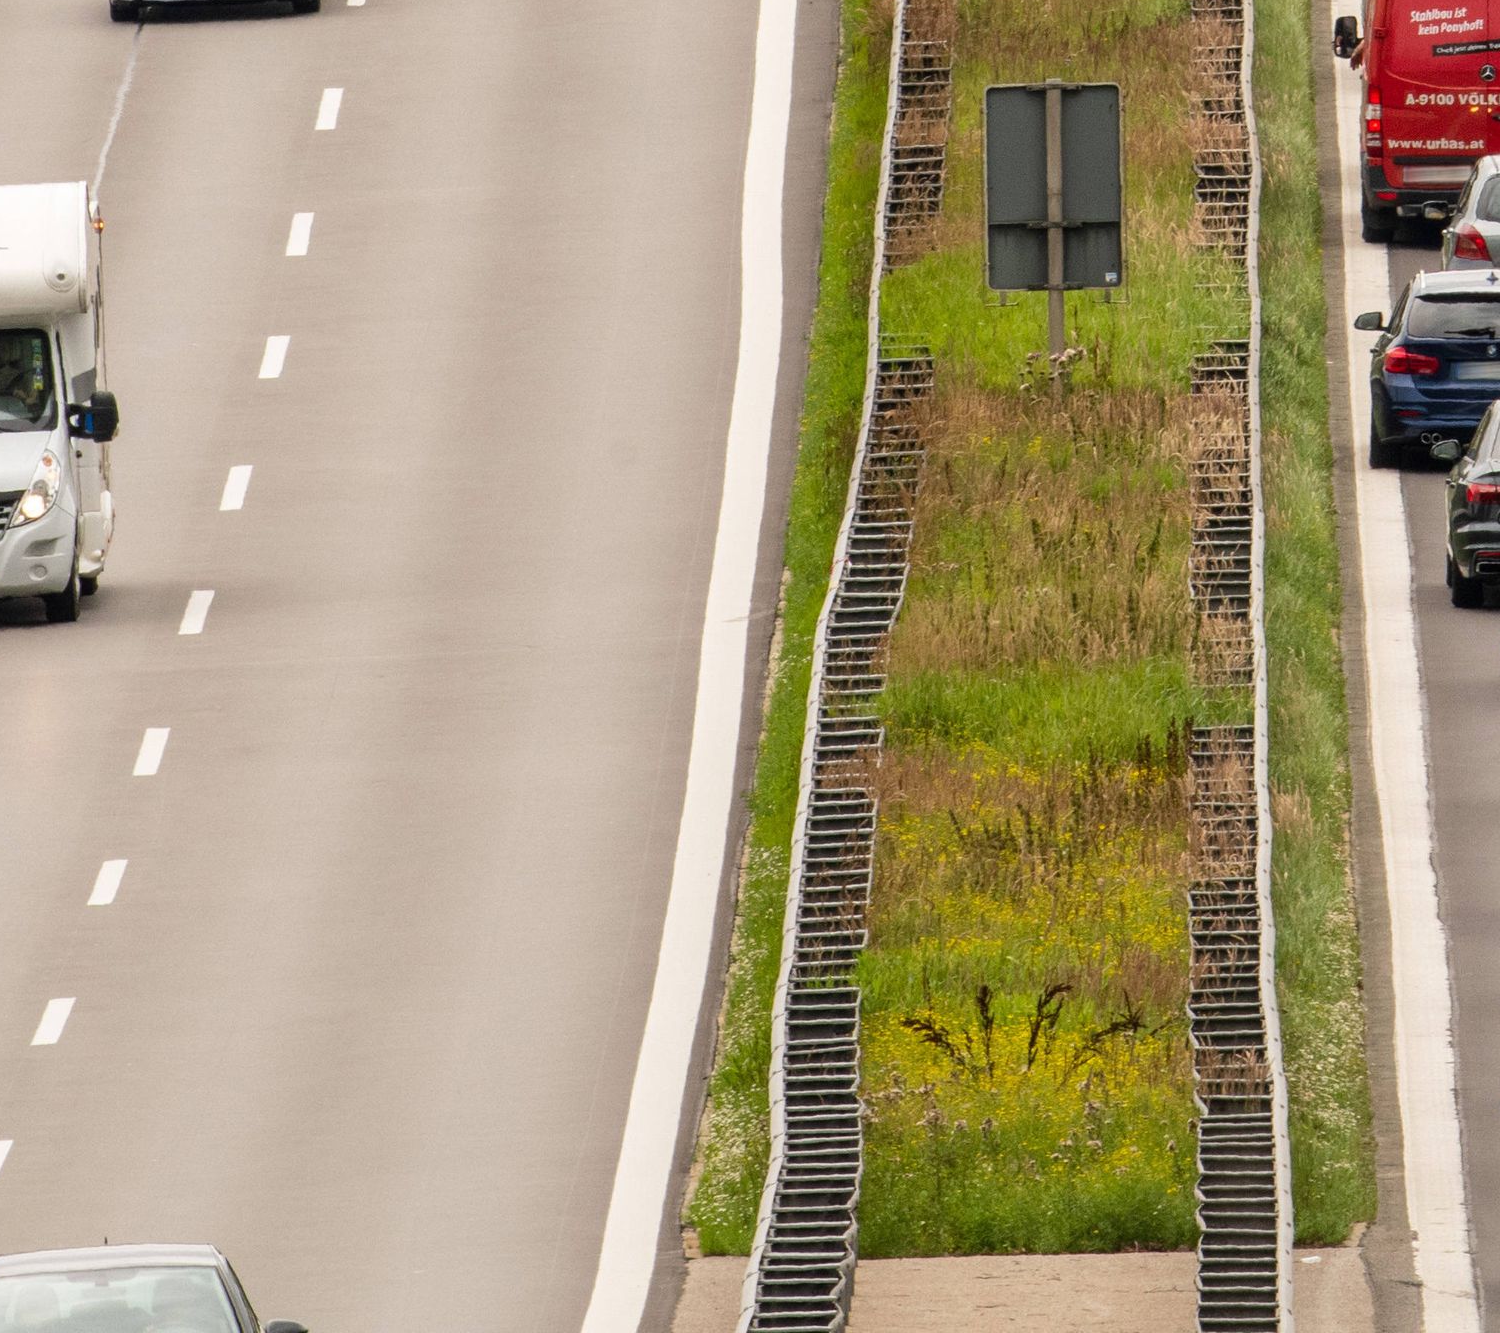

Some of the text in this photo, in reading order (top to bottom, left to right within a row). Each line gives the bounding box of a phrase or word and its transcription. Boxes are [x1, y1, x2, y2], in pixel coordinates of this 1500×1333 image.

[1410, 7, 1468, 23] Stahlbau ist
[1418, 19, 1485, 35] kein Ponyhof!
[1405, 93, 1454, 105] A-9100
[1387, 138, 1484, 150] www.urbas.at
